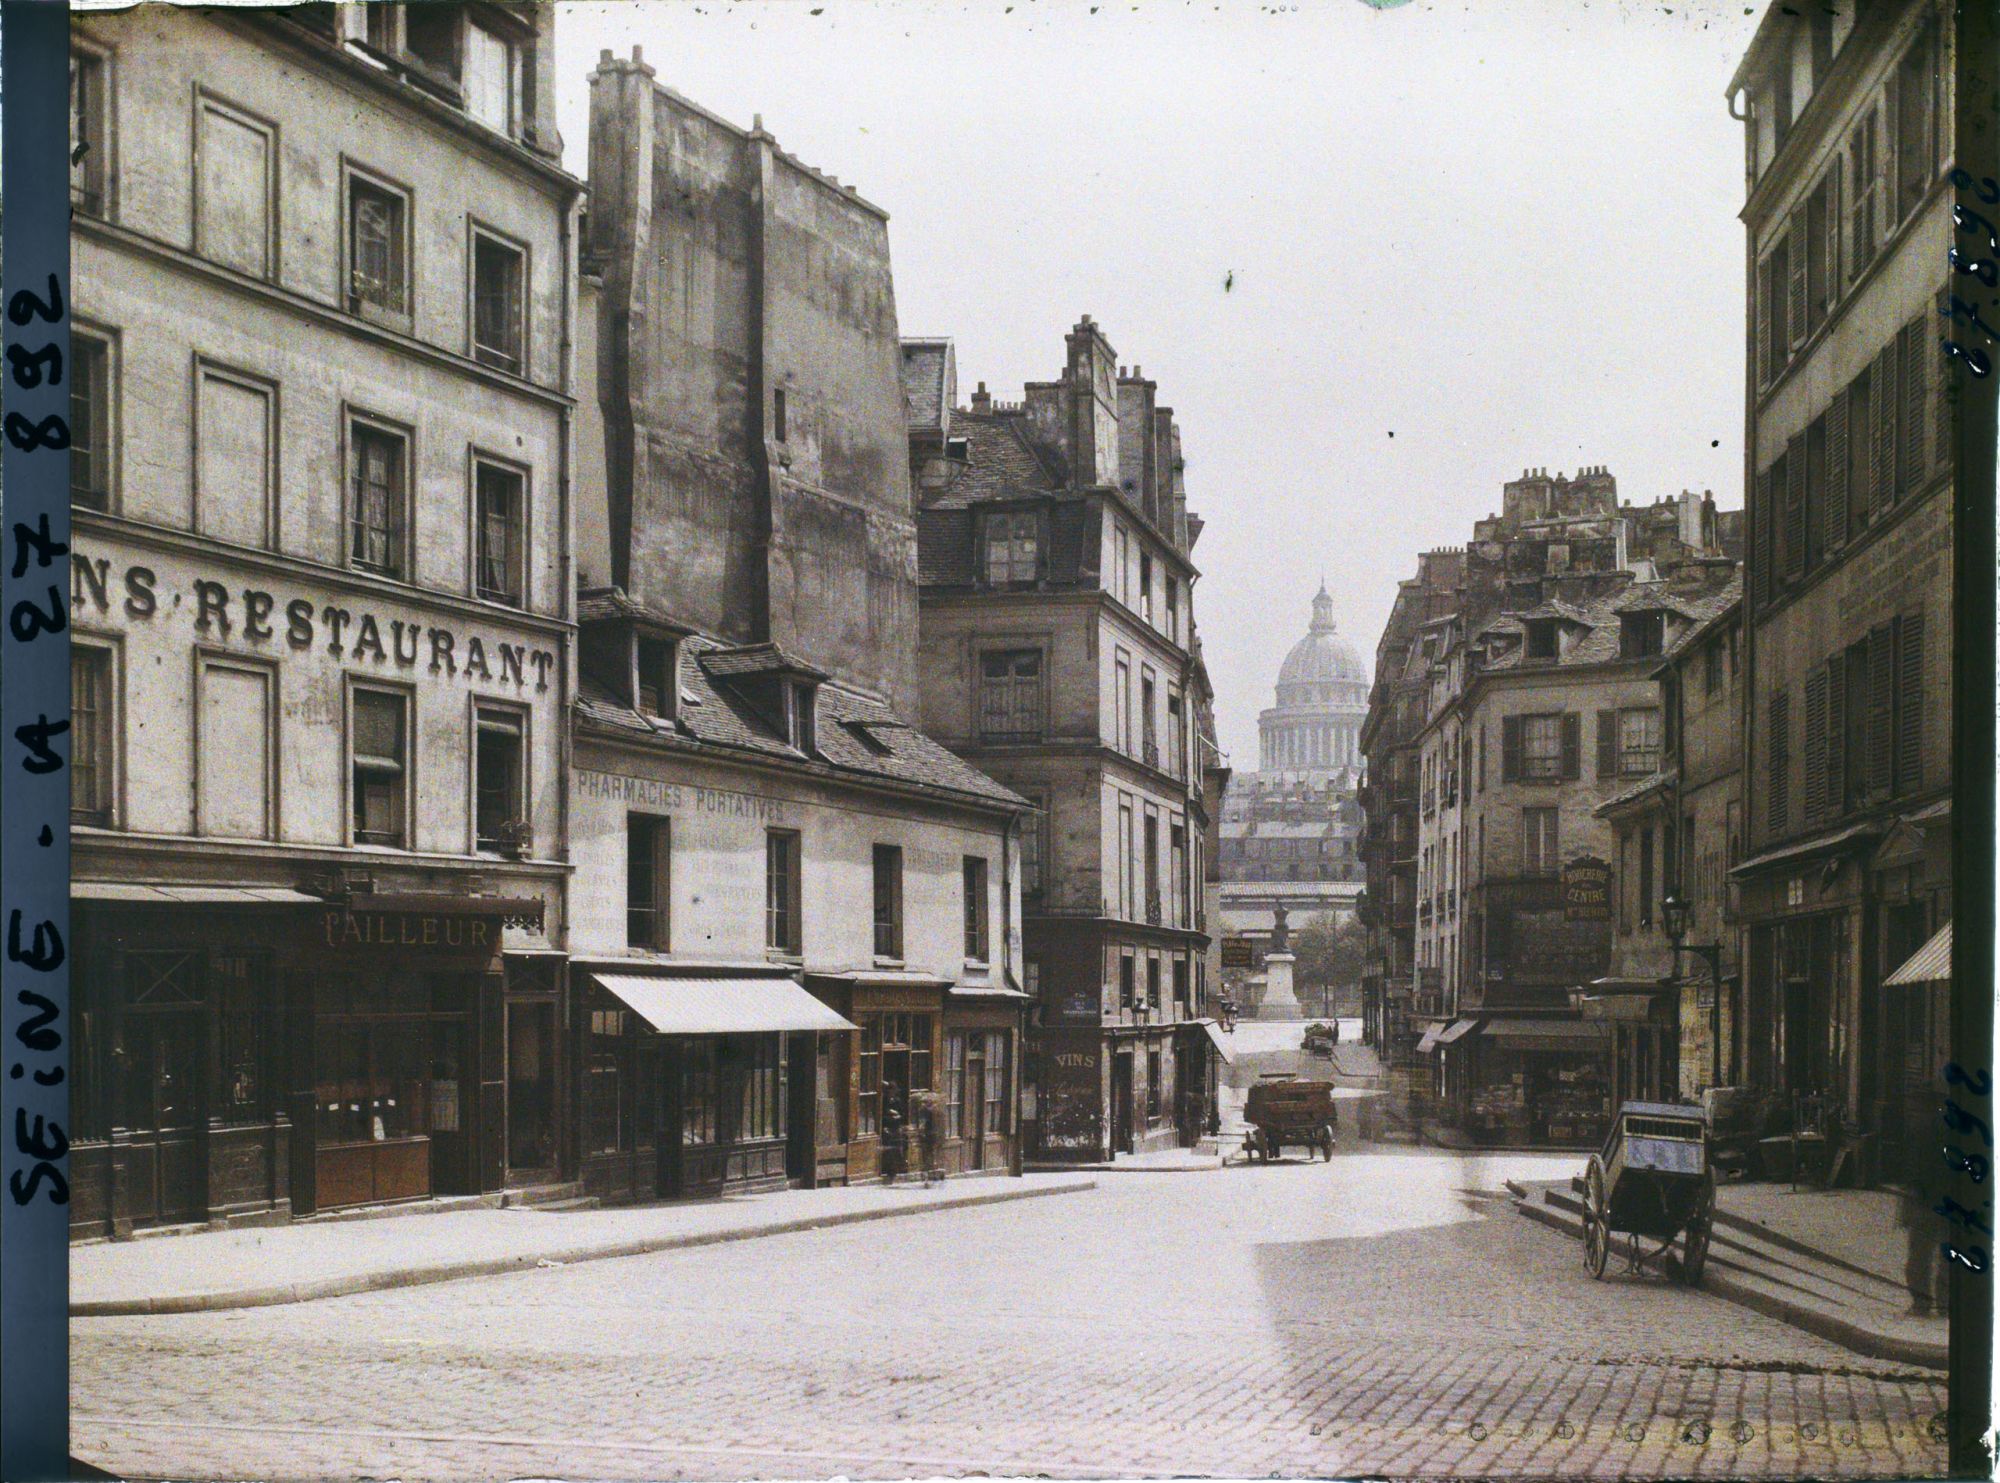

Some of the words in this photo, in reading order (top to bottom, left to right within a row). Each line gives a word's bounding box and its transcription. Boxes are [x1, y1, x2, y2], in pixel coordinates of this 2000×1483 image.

[4, 272, 69, 454] 892
[10, 512, 69, 643] 27
[193, 578, 554, 694] RESTAURANT
[14, 714, 69, 775] A
[578, 772, 682, 808] PHARMACIES
[696, 788, 785, 821] PORTATIVES
[1567, 888, 1607, 903] CENTRE
[324, 911, 489, 946] TAILLEUR
[1055, 1053, 1095, 1068] VINS
